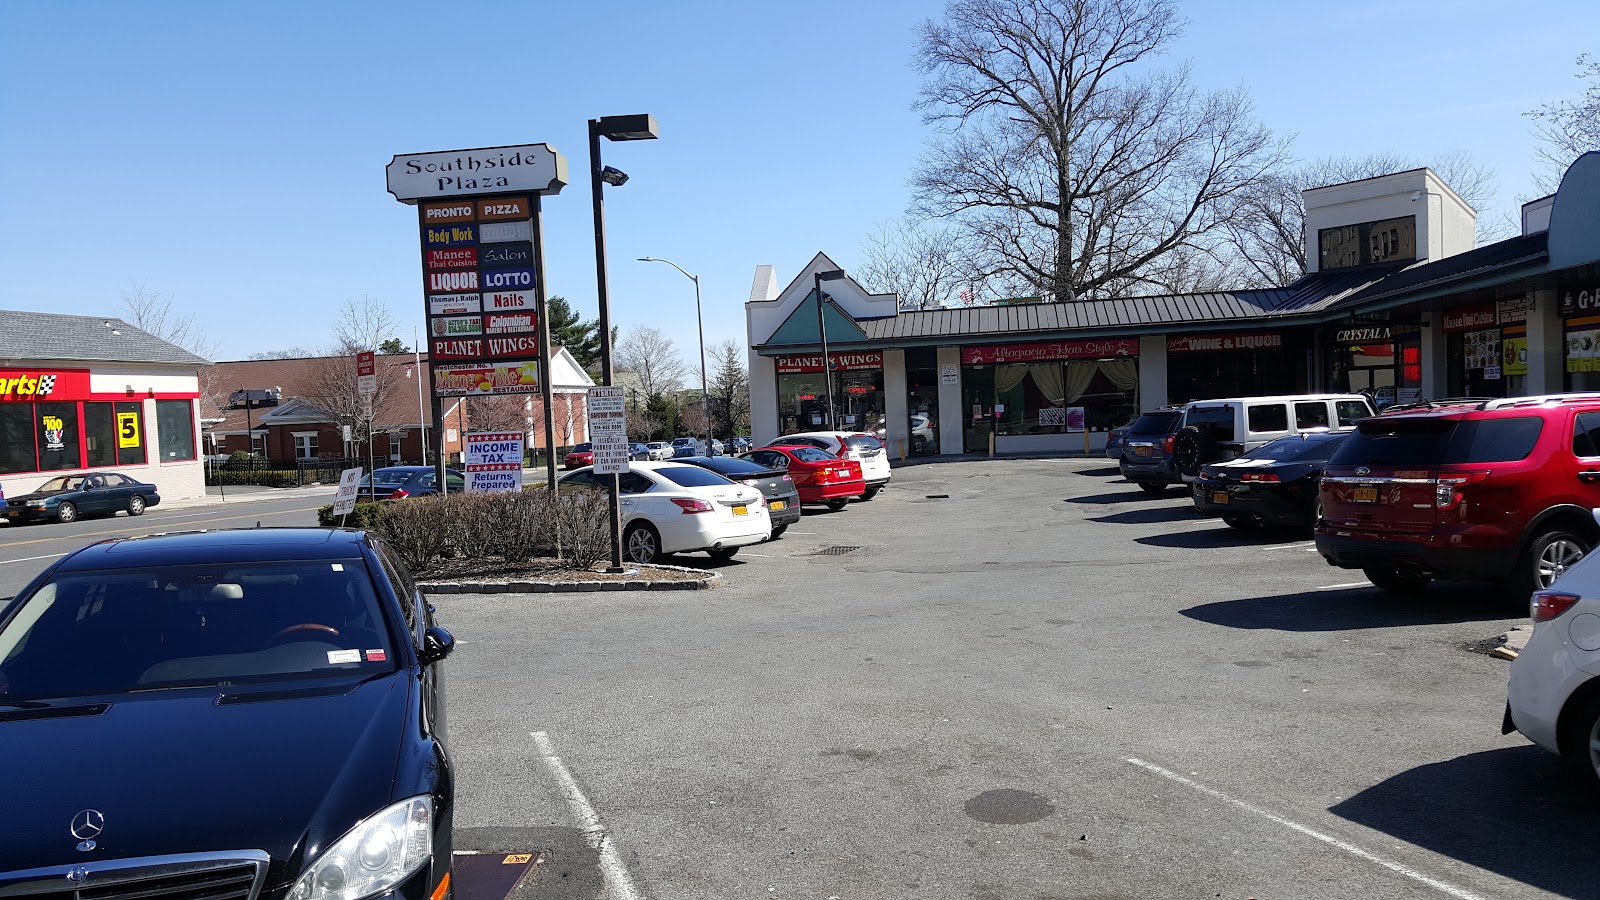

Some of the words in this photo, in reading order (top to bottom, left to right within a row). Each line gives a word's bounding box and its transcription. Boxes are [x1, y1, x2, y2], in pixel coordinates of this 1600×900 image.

[406, 152, 536, 175] Southside
[437, 176, 509, 191] Plaza
[427, 206, 472, 218] PRONTO
[484, 204, 520, 215] PIZZA
[428, 229, 449, 245] Body
[451, 227, 473, 242] Work
[432, 250, 471, 260] Manee
[484, 249, 527, 262] Salon
[429, 260, 446, 268] Thai
[448, 259, 477, 267] Cuisine
[431, 272, 478, 291] LIQUOR
[486, 272, 530, 287] LOTTO
[460, 295, 479, 303] Ralph
[494, 294, 524, 307] Nails
[490, 315, 531, 327] Colombian
[1473, 311, 1494, 325] Cuisine
[1336, 328, 1381, 342] CRYSTAL
[436, 340, 481, 356] PLANET
[488, 337, 535, 355] WINGS
[1048, 344, 1082, 355] Hair
[1085, 342, 1114, 355] Style
[1188, 337, 1222, 350] WINE
[1223, 339, 1234, 348] &
[1235, 335, 1281, 348] LIQUOR
[779, 357, 824, 367] PLANET
[839, 354, 881, 366] WINGS
[493, 385, 538, 393] RESTAURANT
[590, 388, 623, 397] ATTENTION
[470, 443, 518, 453] INCOME
[481, 454, 504, 463] TAX
[347, 472, 355, 483] NO
[474, 473, 512, 481] Returns
[341, 485, 355, 496] TRUCKS
[472, 480, 515, 491] Prepared
[334, 498, 355, 511] PERMITTED
